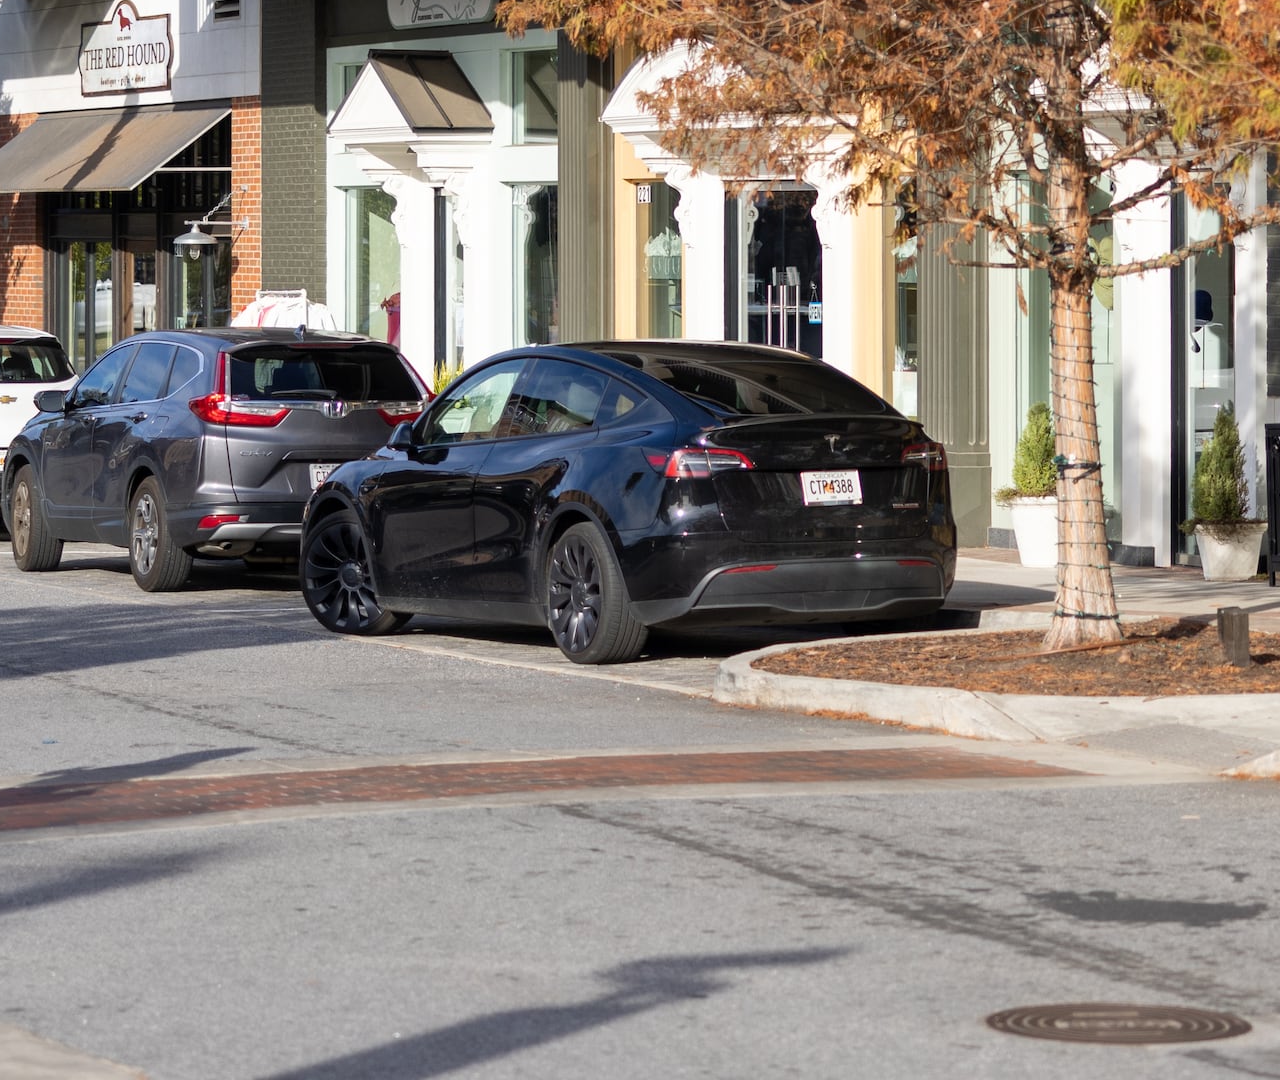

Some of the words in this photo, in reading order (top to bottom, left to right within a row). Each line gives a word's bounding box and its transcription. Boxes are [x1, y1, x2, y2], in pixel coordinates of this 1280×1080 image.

[84, 48, 103, 71] THE
[105, 46, 124, 69] RED
[127, 41, 166, 67] HOUND
[638, 186, 649, 202] 221
